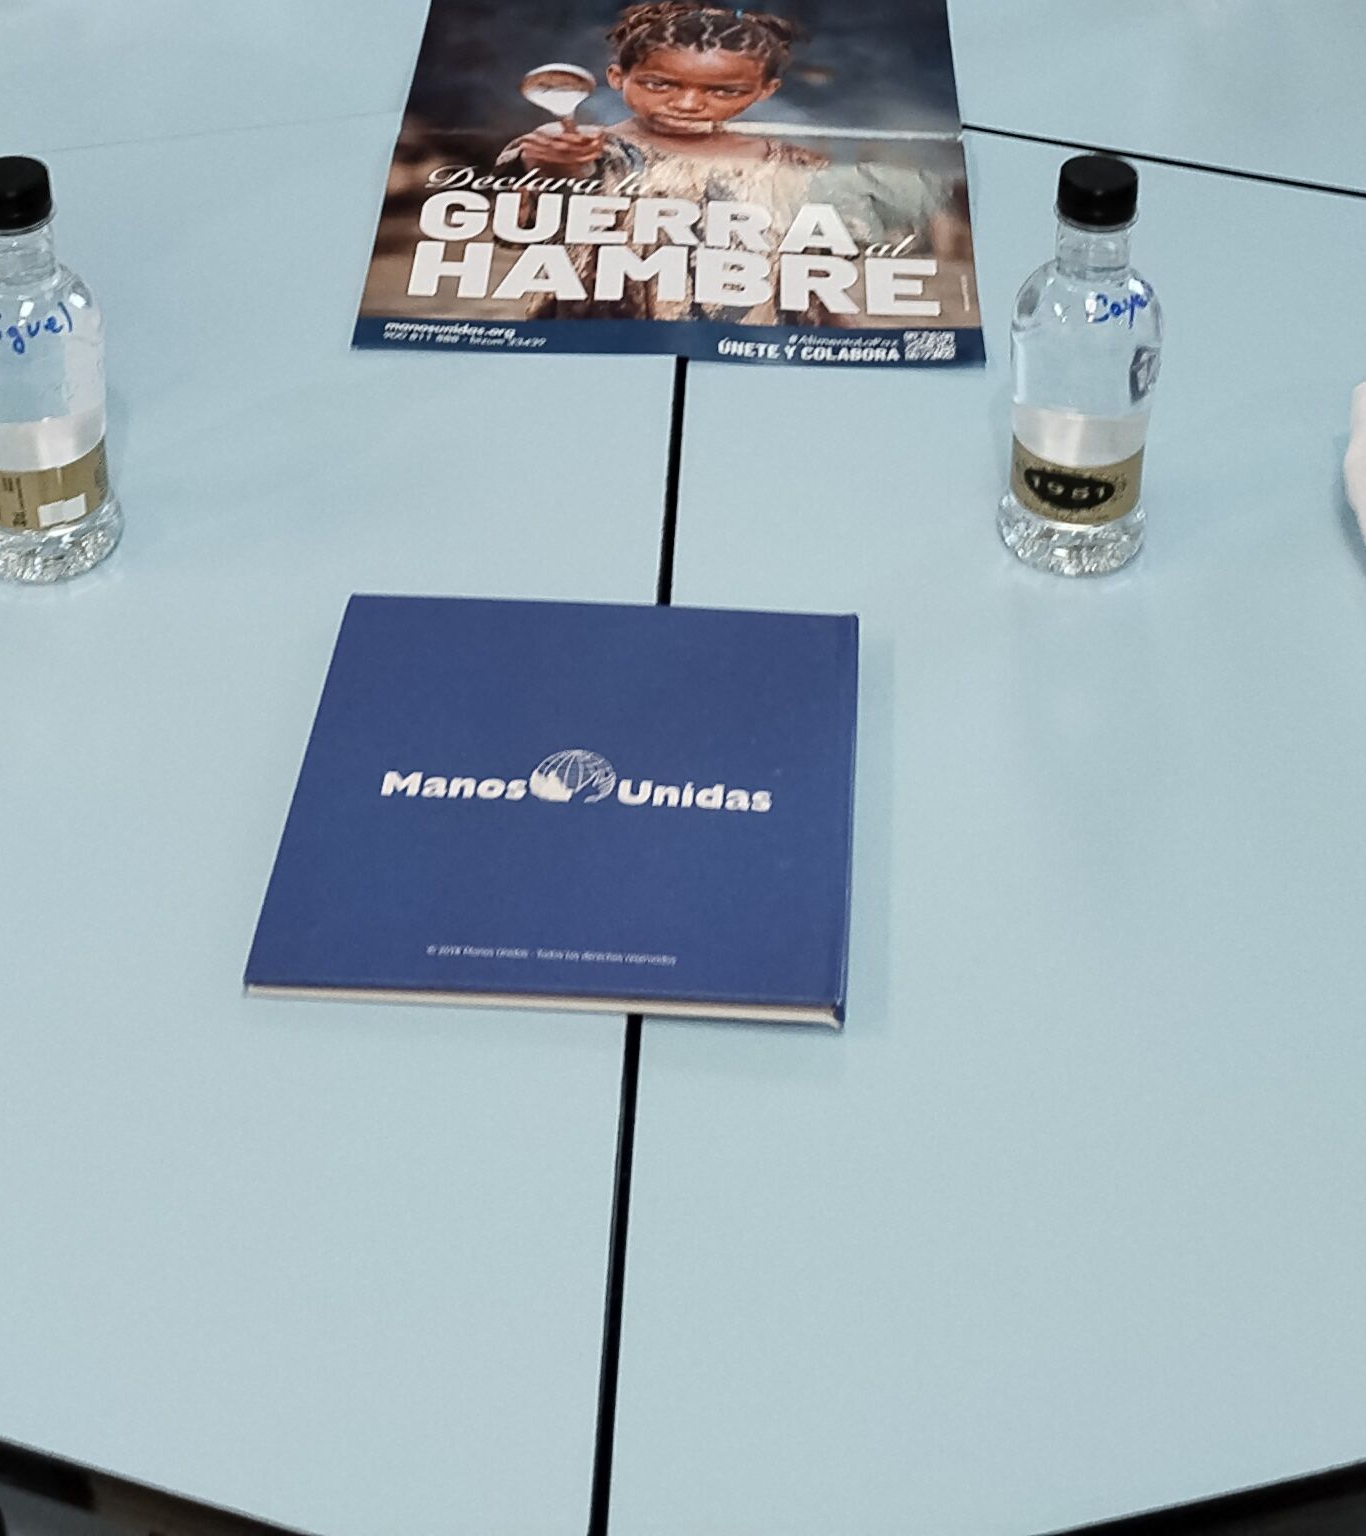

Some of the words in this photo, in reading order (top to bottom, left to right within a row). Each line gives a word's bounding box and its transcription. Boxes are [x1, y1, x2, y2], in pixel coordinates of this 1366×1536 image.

[425, 165, 603, 193] Declara
[419, 189, 860, 255] GUERRA
[407, 241, 941, 317] HAMBRE
[384, 321, 517, 340] manosunidas.org
[717, 336, 781, 360] ÚNETE
[784, 345, 798, 361] Y
[800, 346, 901, 362] COLABORA
[380, 770, 529, 801] Manos
[616, 777, 773, 813] Unidas
[462, 945, 494, 958] Manos
[496, 946, 529, 958] Unidas
[581, 950, 623, 963] derechos
[624, 952, 677, 966] reservados
